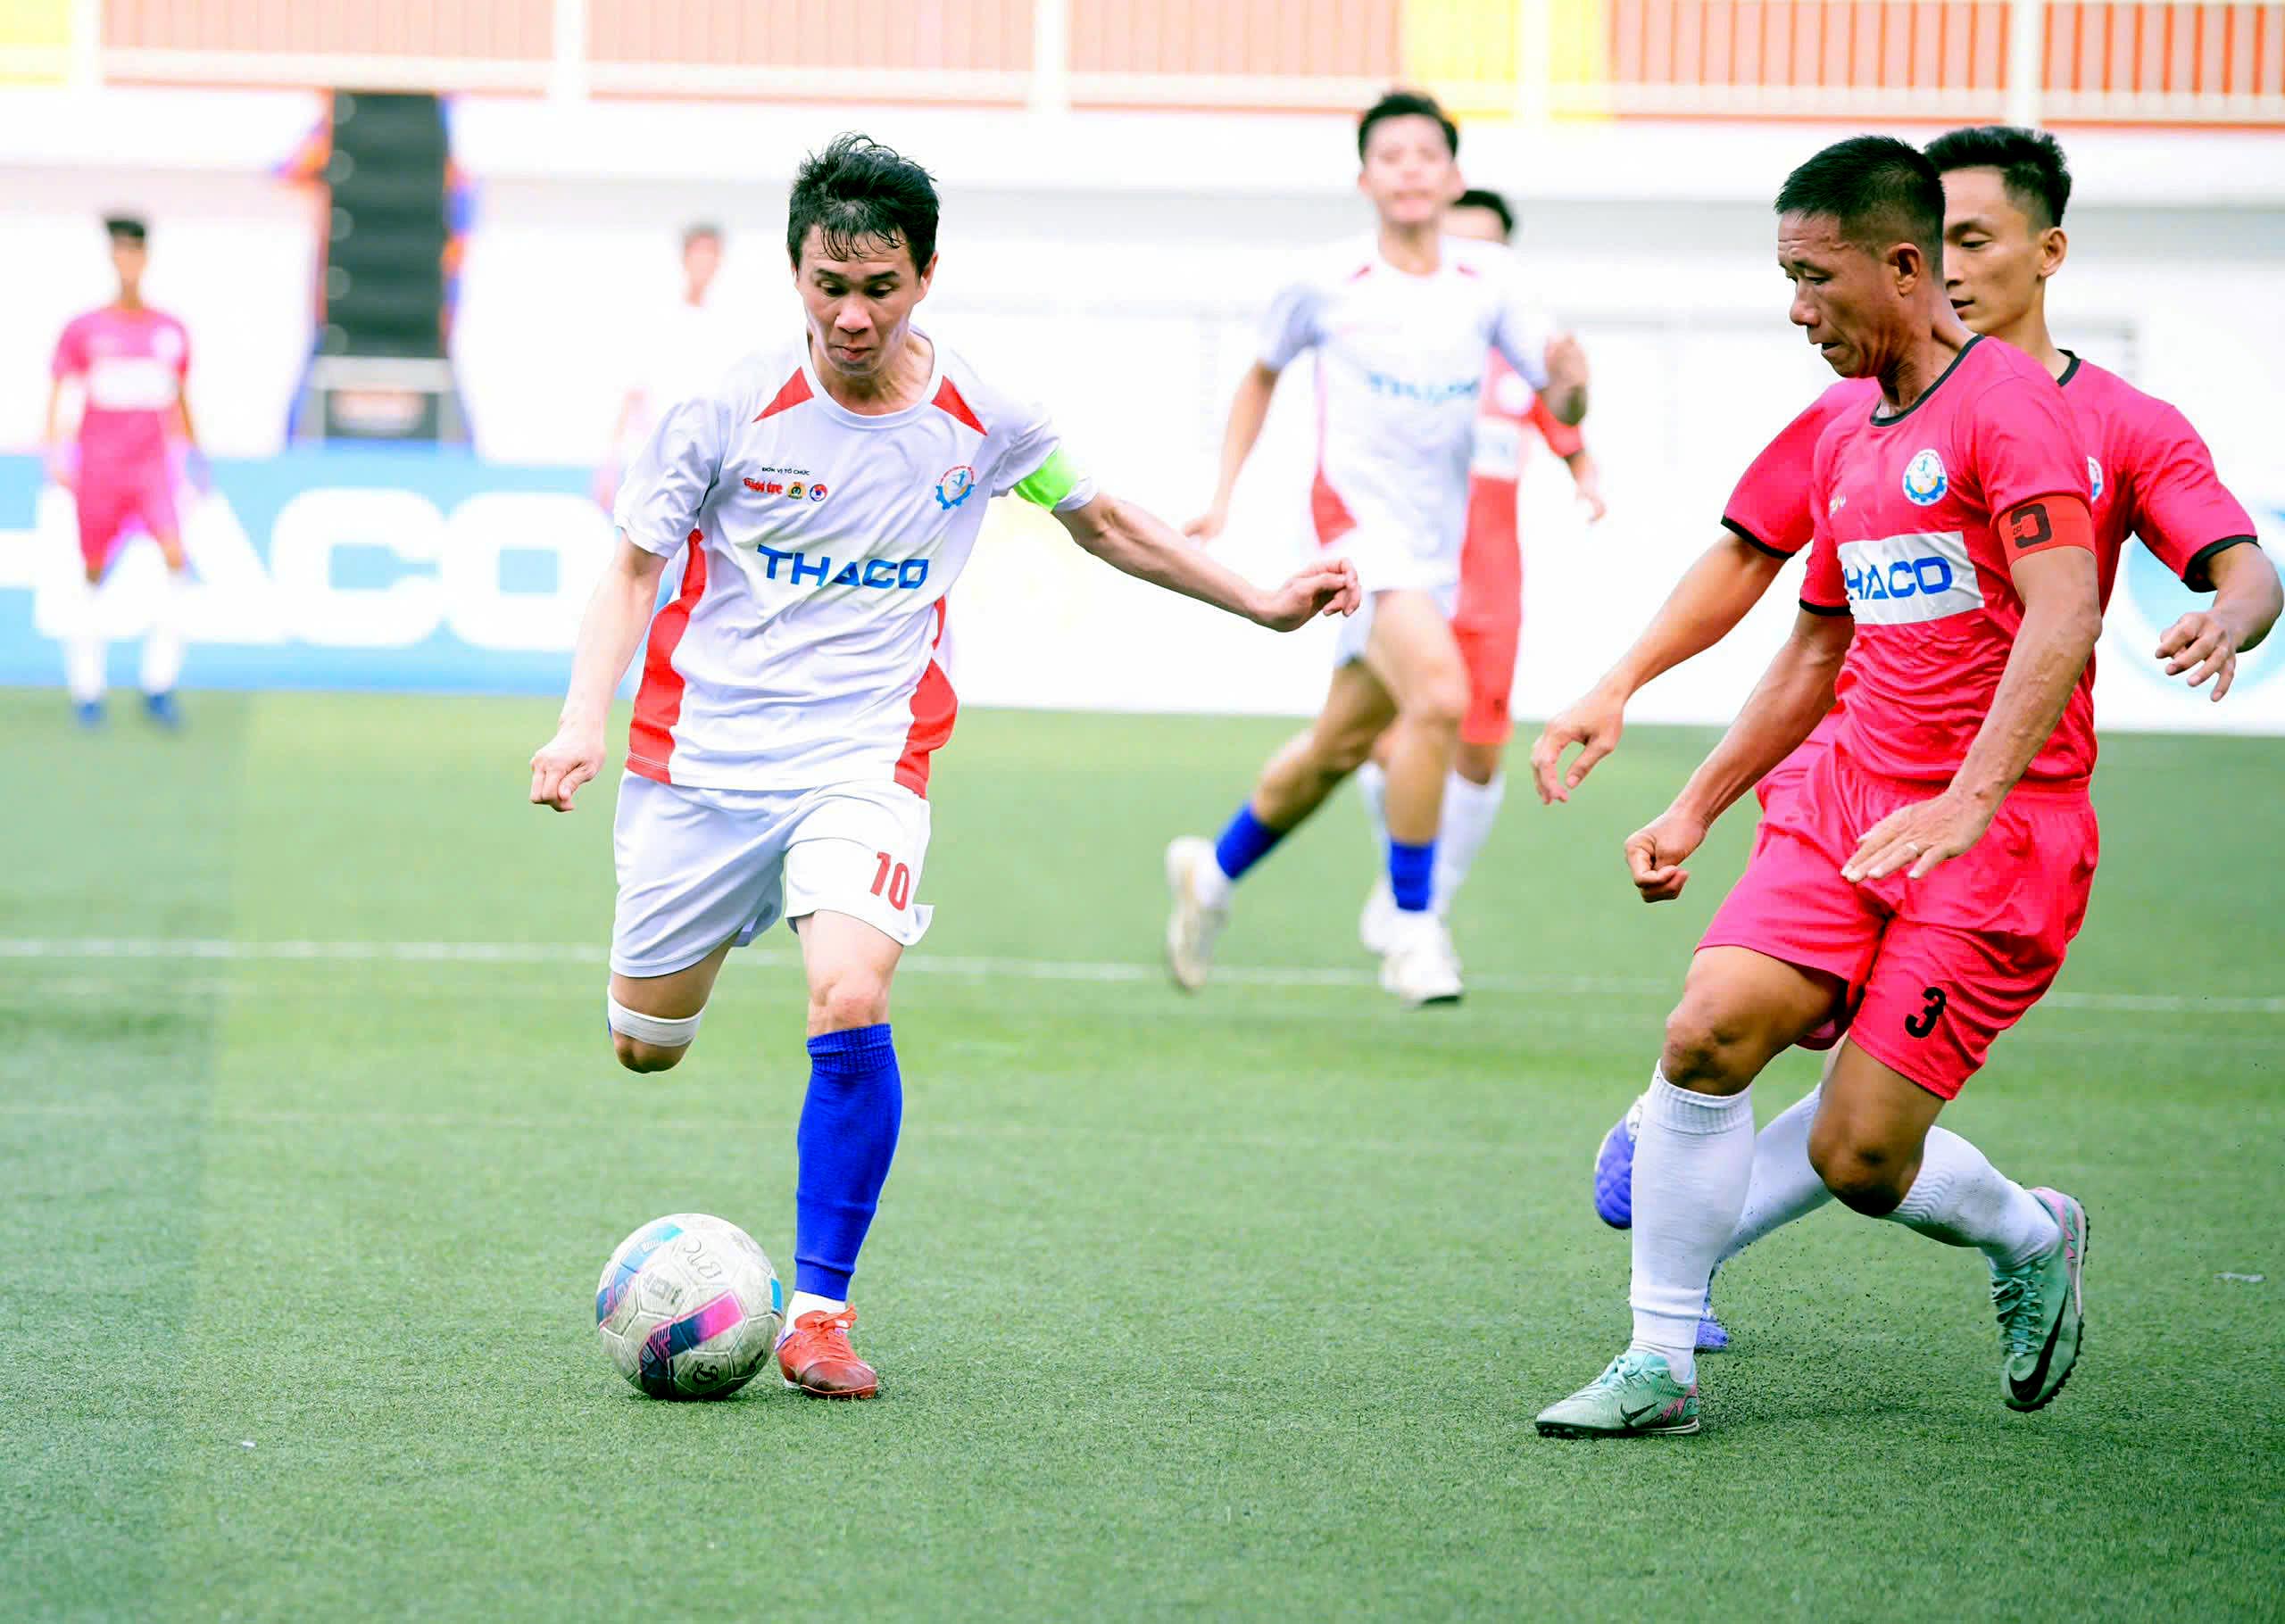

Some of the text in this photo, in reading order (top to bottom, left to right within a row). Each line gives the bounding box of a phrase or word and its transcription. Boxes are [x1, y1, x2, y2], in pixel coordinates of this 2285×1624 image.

[757, 543, 929, 590] THACO
[870, 851, 910, 912] 10
[1905, 986, 1948, 1039] 3
